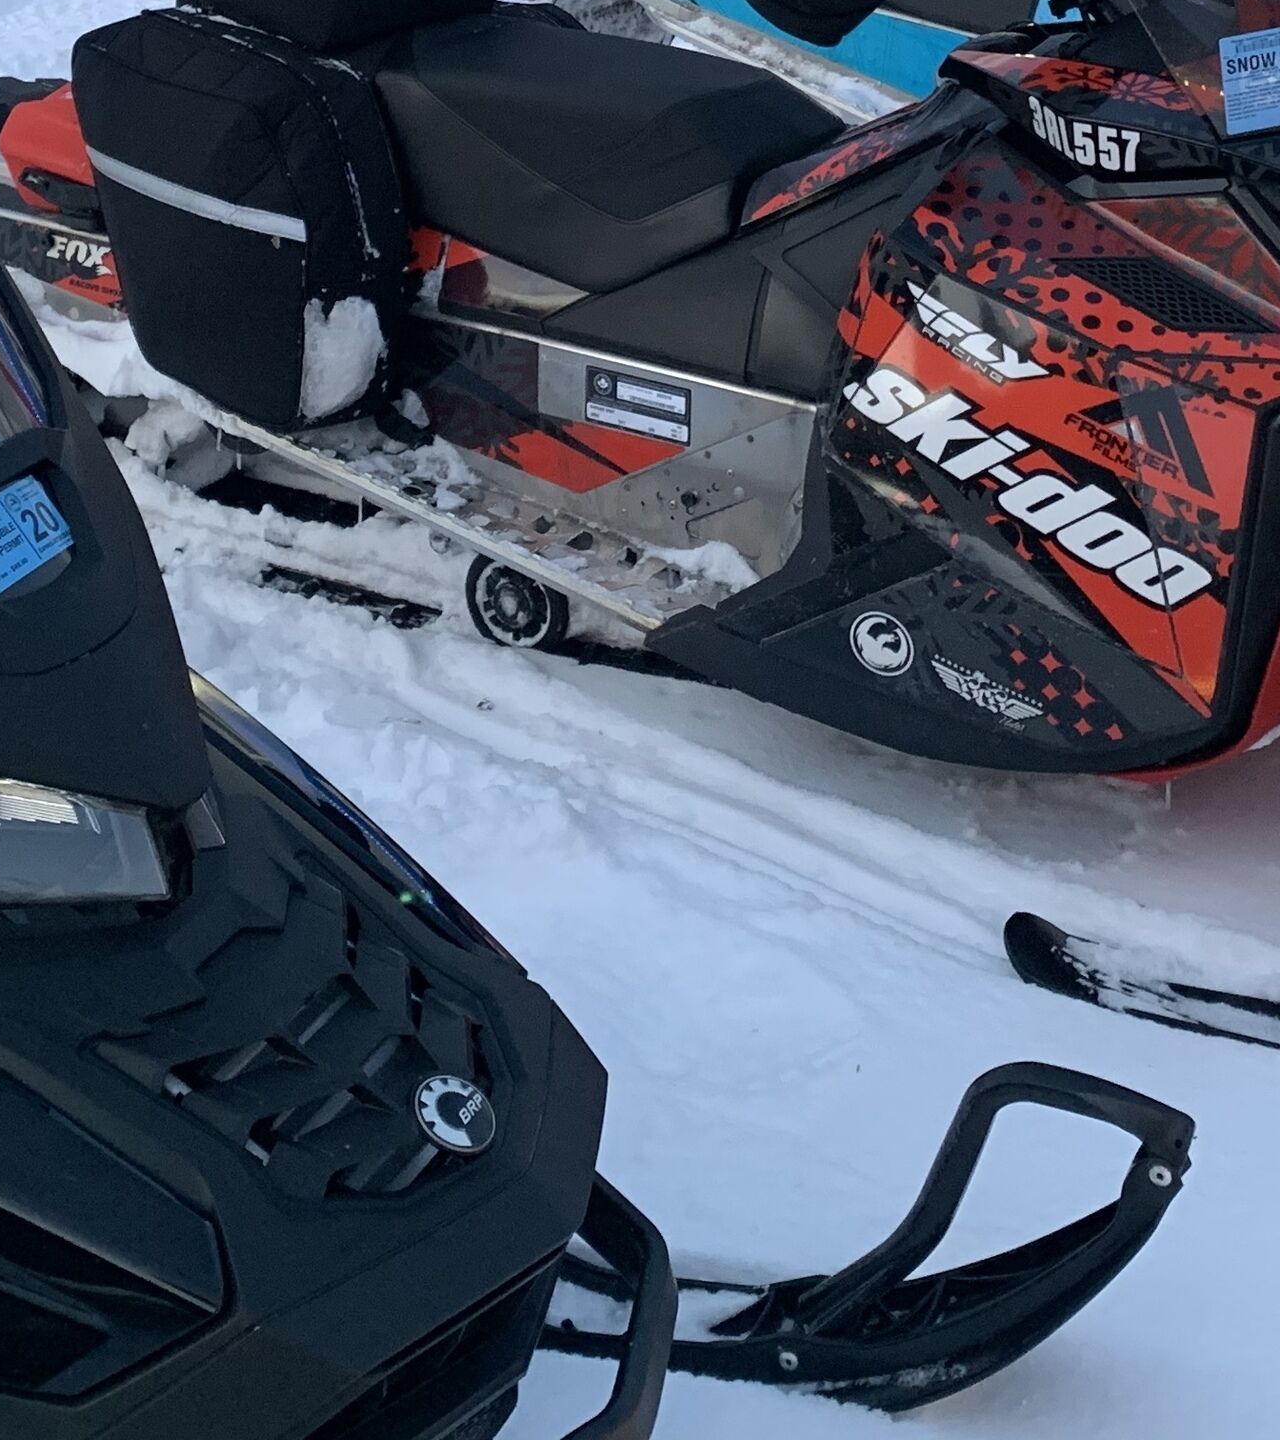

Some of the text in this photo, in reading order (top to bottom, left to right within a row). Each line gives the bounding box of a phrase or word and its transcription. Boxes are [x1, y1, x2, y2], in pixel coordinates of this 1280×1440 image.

[1226, 51, 1277, 76] SNOW
[1027, 95, 1141, 173] 3AL557
[46, 234, 112, 269] FOX
[907, 280, 1050, 380] FLY
[921, 326, 1005, 384] RACING
[1063, 412, 1179, 480] FRONTIER
[1092, 441, 1138, 473] FILMS
[842, 368, 1214, 607] ski-doo
[20, 500, 61, 544] 20
[458, 1092, 483, 1126] BRP
